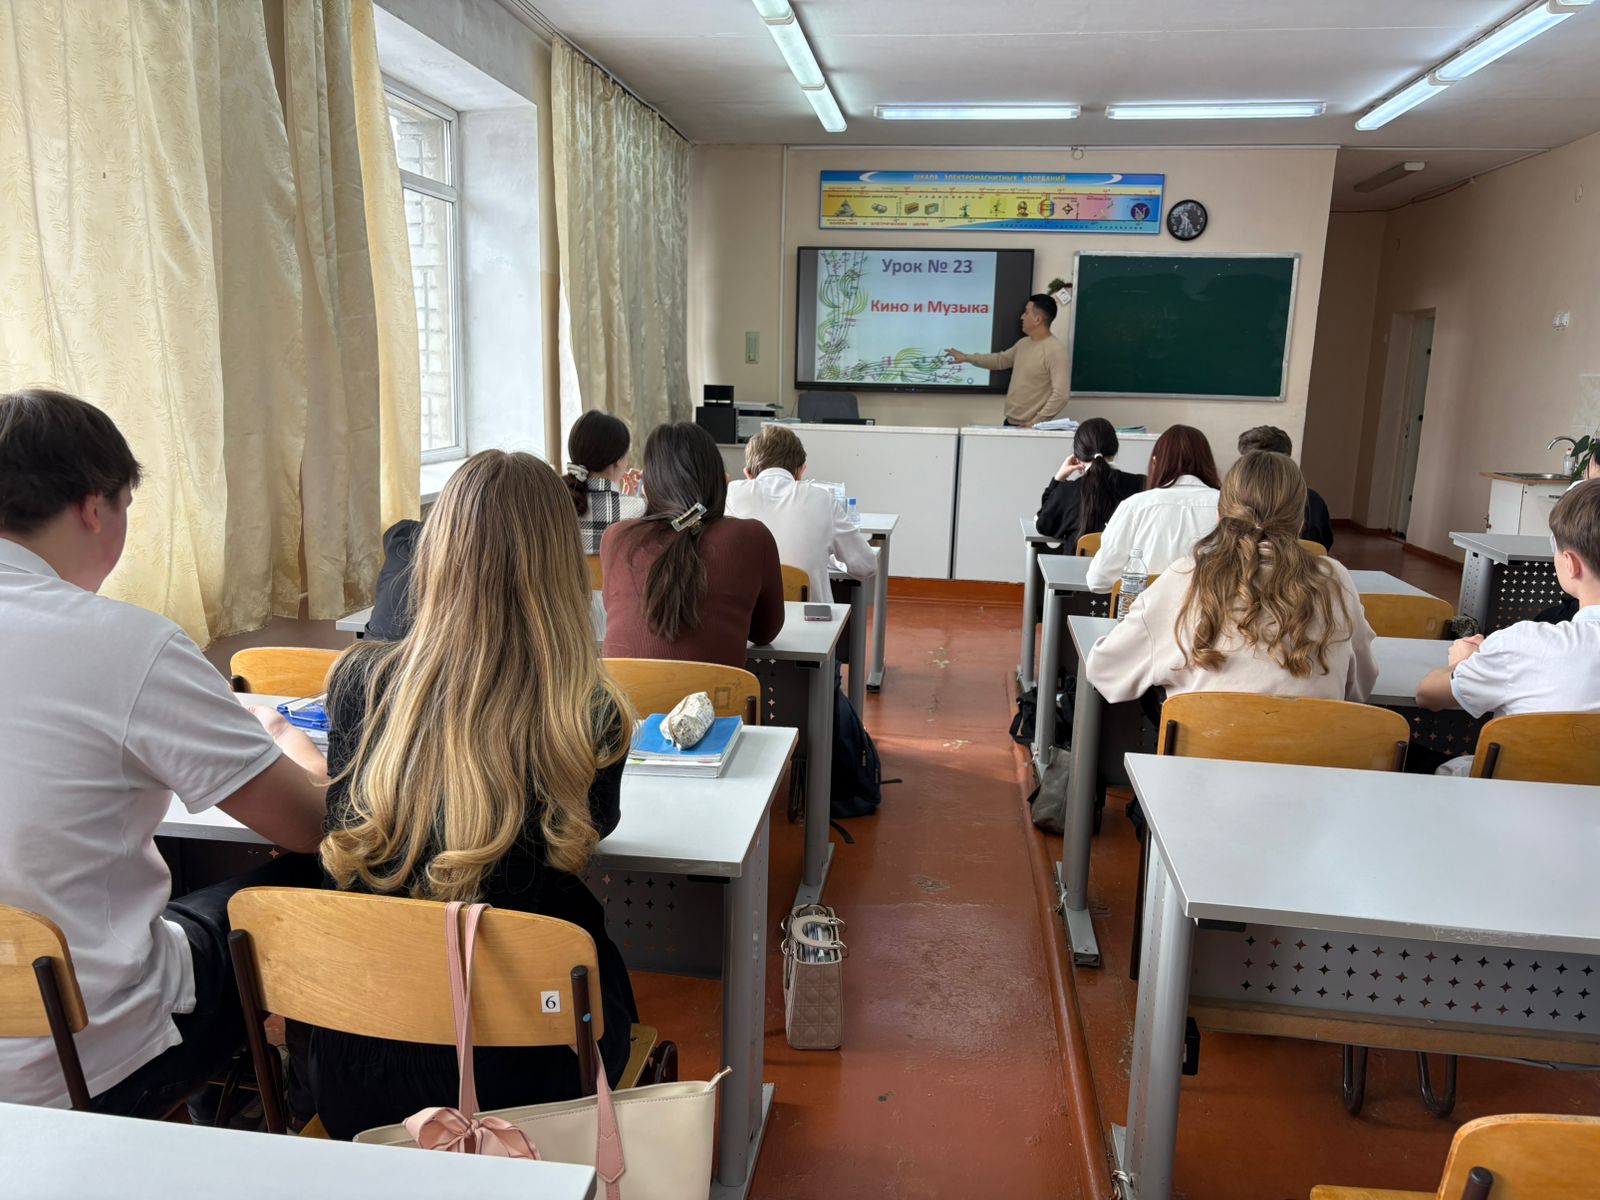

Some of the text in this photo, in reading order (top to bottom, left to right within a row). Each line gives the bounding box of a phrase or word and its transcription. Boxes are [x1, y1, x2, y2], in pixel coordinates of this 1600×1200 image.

[882, 258, 973, 276] Урок № 23
[870, 299, 989, 316] Кино и Музыка
[545, 994, 557, 1010] 6
